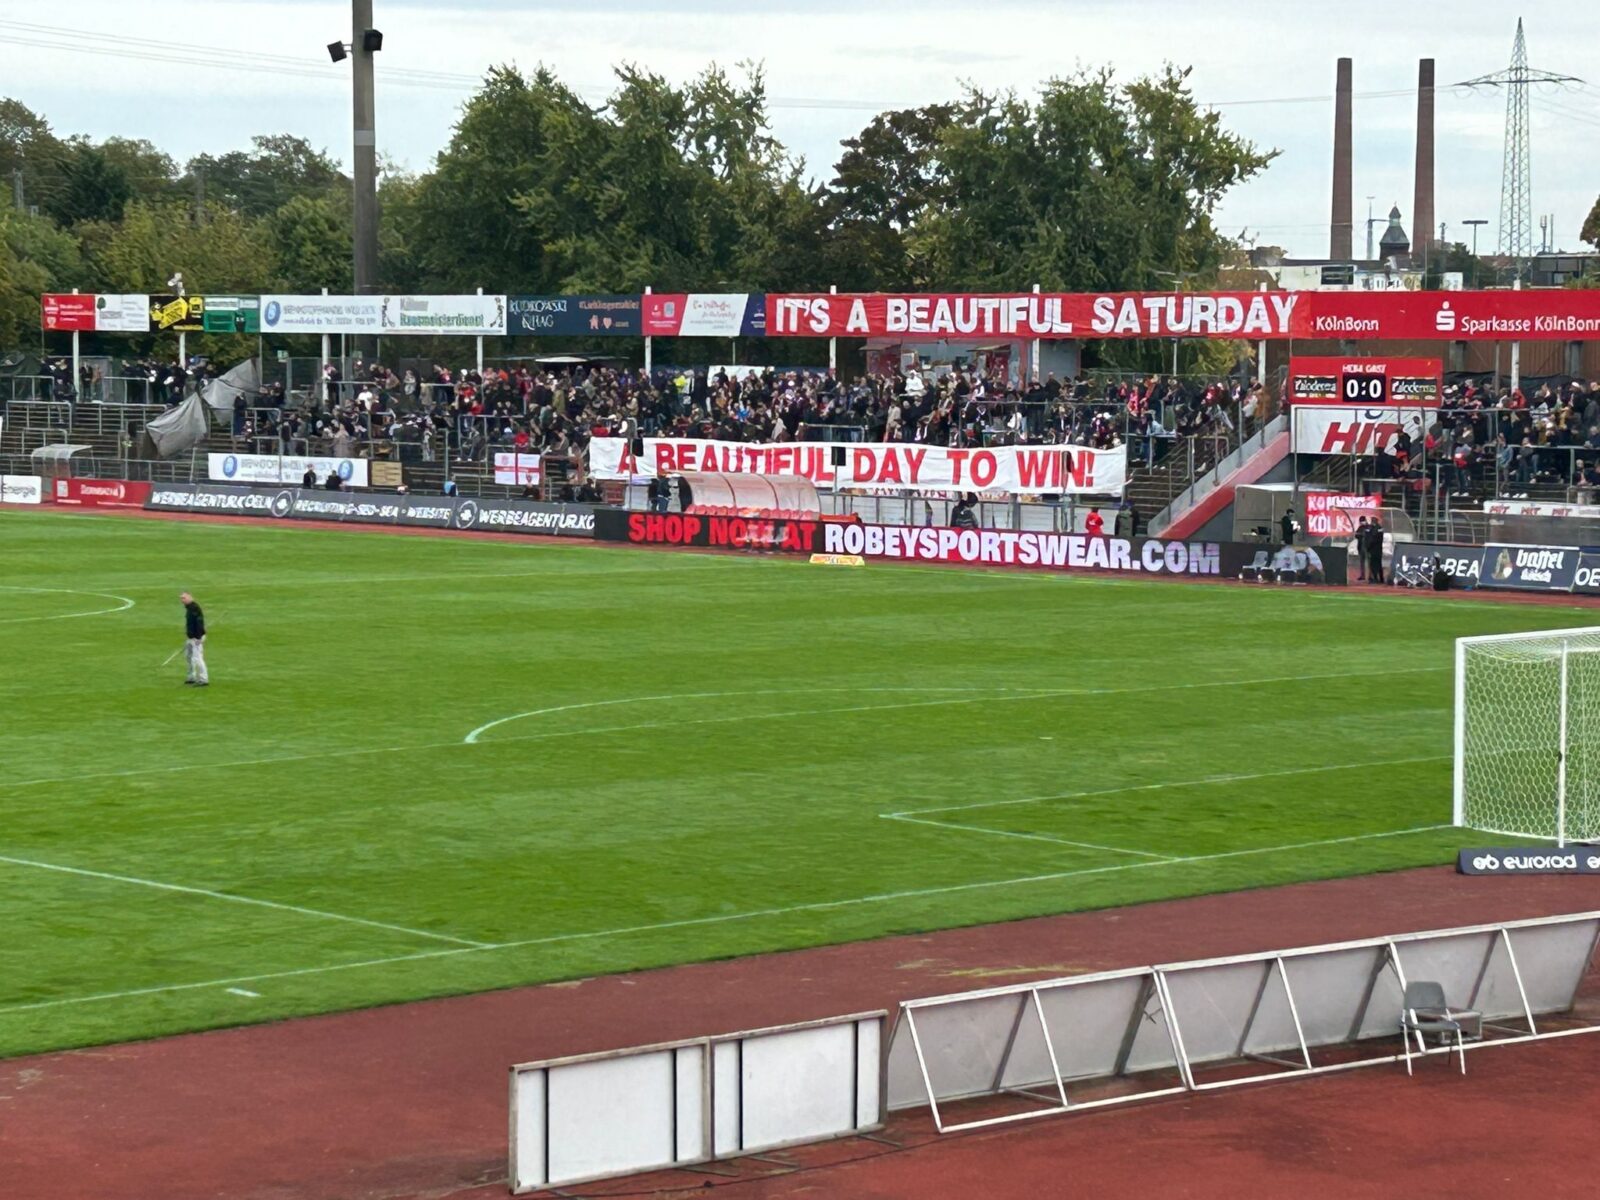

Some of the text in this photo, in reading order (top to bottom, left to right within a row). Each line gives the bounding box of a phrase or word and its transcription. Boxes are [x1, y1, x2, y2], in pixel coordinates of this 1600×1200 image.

[775, 298, 830, 333] IT'S
[846, 299, 870, 332] A
[886, 297, 1073, 333] BEAUTIFUL
[1091, 295, 1299, 333] SATURDAY
[1316, 316, 1379, 332] KölnBonn
[1461, 315, 1531, 334] Sparkasse
[1321, 422, 1404, 453] HIT
[617, 442, 1096, 488] A BEAUTIFUL DAY TO WIN!
[628, 513, 701, 545] SHOP
[781, 521, 817, 550] AT
[824, 523, 1221, 575] ROBEYSPORTSWEAR.COM
[1503, 854, 1577, 869] eurorad
